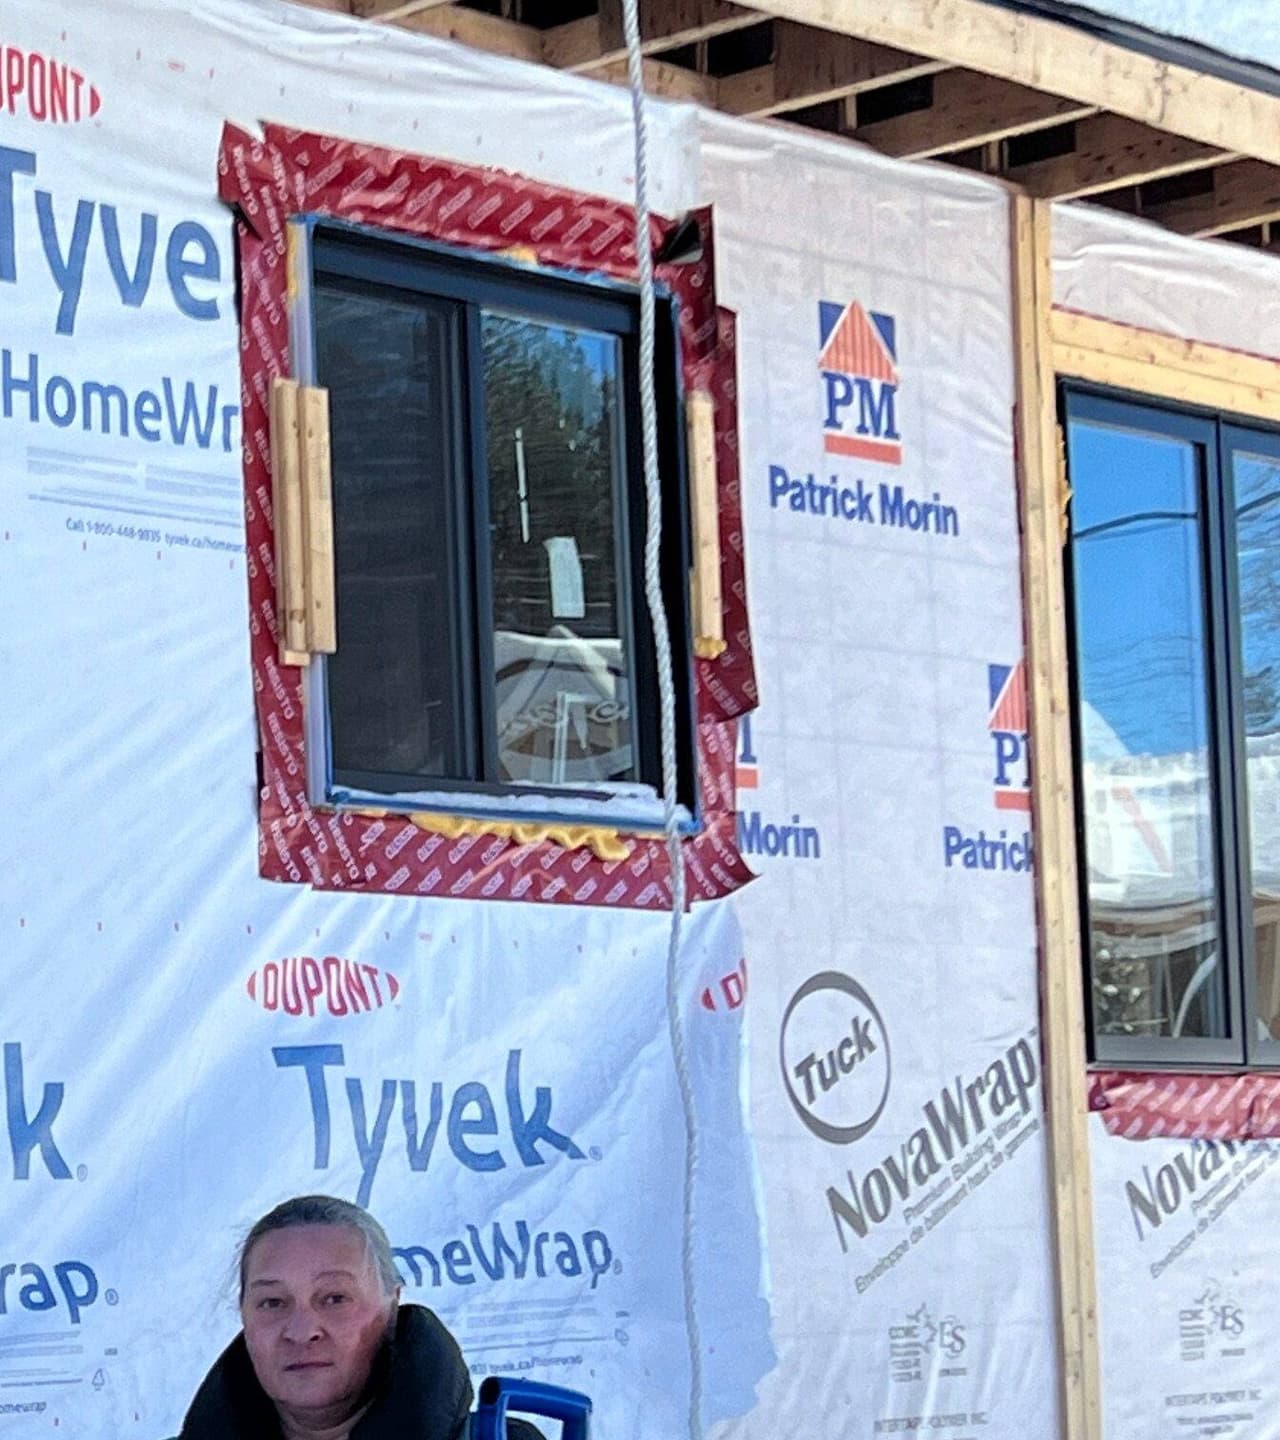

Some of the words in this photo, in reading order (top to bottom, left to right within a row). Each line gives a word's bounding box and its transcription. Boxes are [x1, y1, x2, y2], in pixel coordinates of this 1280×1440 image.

[2, 349, 239, 452] HomeWr
[822, 372, 899, 441] PM
[769, 466, 874, 526] Patrick
[880, 483, 960, 536] Morin
[262, 957, 383, 1017] DUPONT
[795, 1015, 878, 1106] Tuck
[826, 1037, 1037, 1254] NovaWrap
[394, 1221, 615, 1289] meWrap
